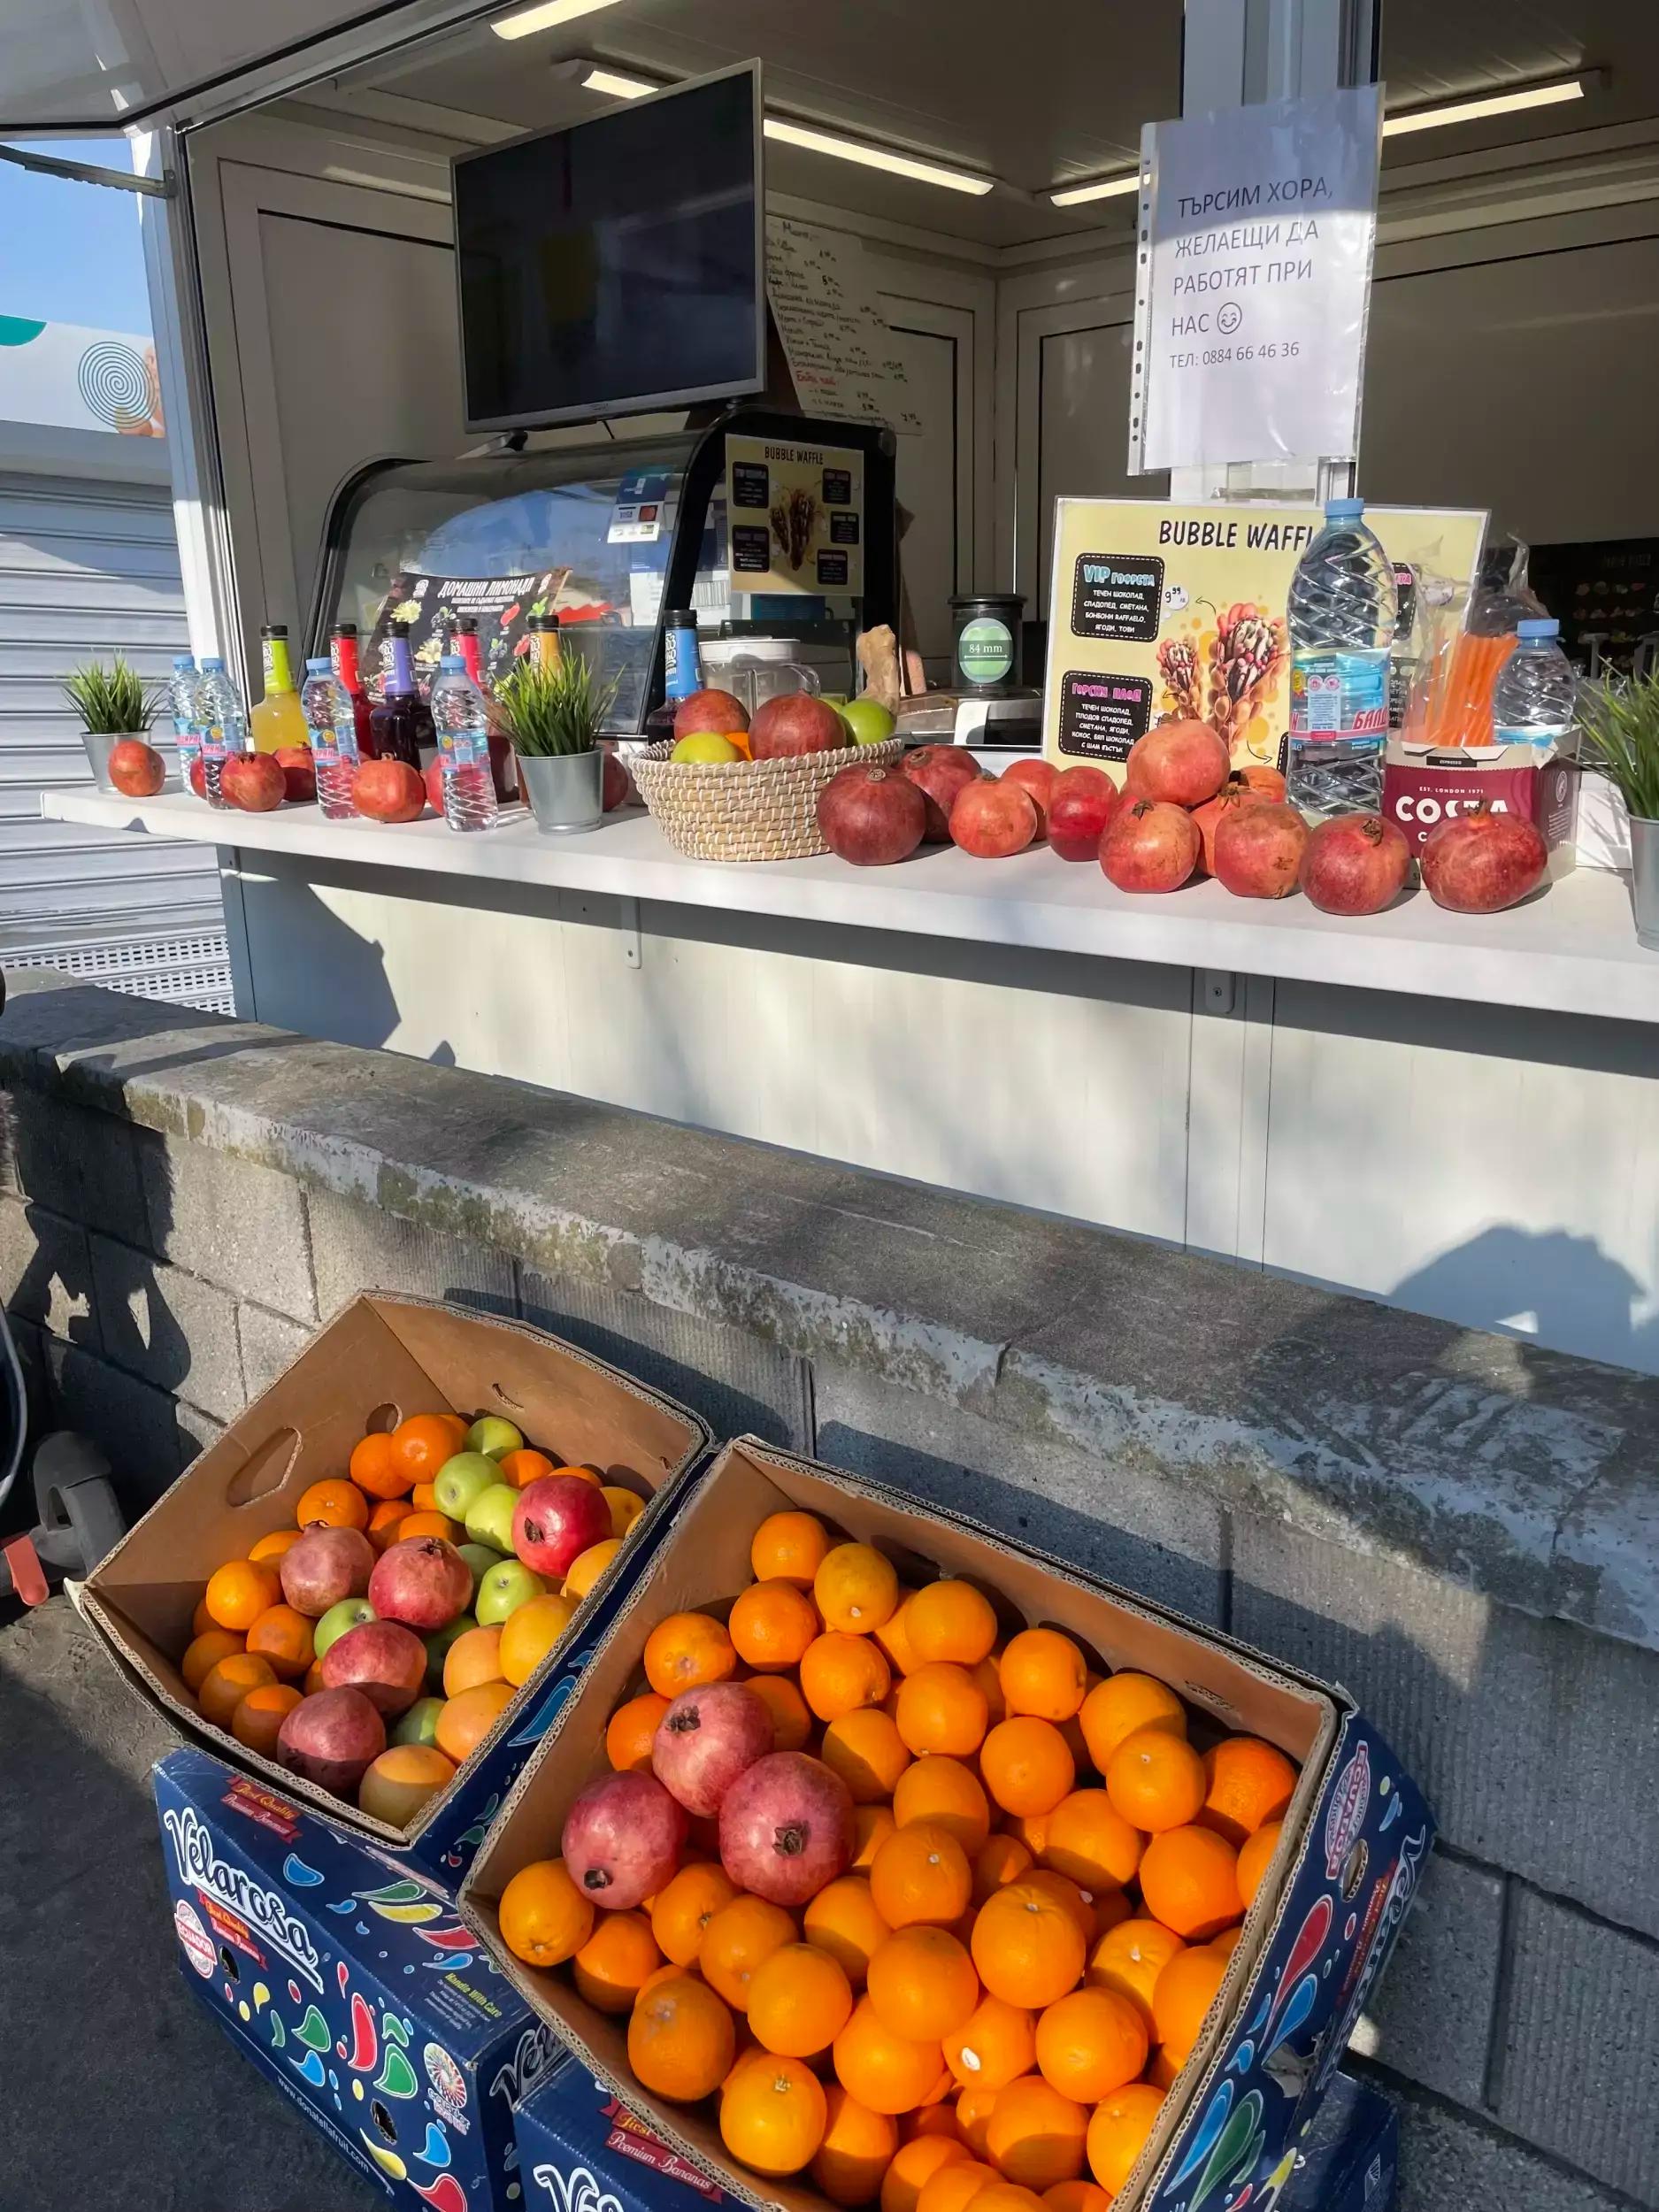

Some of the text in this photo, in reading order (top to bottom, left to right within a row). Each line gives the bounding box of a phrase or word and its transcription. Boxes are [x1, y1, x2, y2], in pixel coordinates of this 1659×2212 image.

[1178, 176, 1333, 218] ТЪРСИМ ХОРА,
[1175, 219, 1318, 258] ЖЕЛАЕЩИ ДА
[1173, 259, 1312, 296] РАБОТЯТ ПРИ
[1171, 311, 1210, 336] НАС
[1170, 342, 1300, 368] ТЕЛ: 0884 66 46 36
[764, 446, 824, 465] BUBBLE WAFFLE
[1159, 519, 1313, 552] BUBBLE WAFFL
[437, 580, 488, 599] ДОМАШНИ
[1083, 564, 1110, 584] VIP
[969, 643, 1003, 654] 84 mm
[1329, 1748, 1368, 1870] ECUADOR
[164, 1806, 320, 1973] Velarosa
[176, 1922, 214, 1959] ECUADOR
[444, 1972, 471, 1993] Handle
[469, 1989, 488, 2006] With
[483, 2001, 503, 2018] Care
[608, 2131, 656, 2165] Premium
